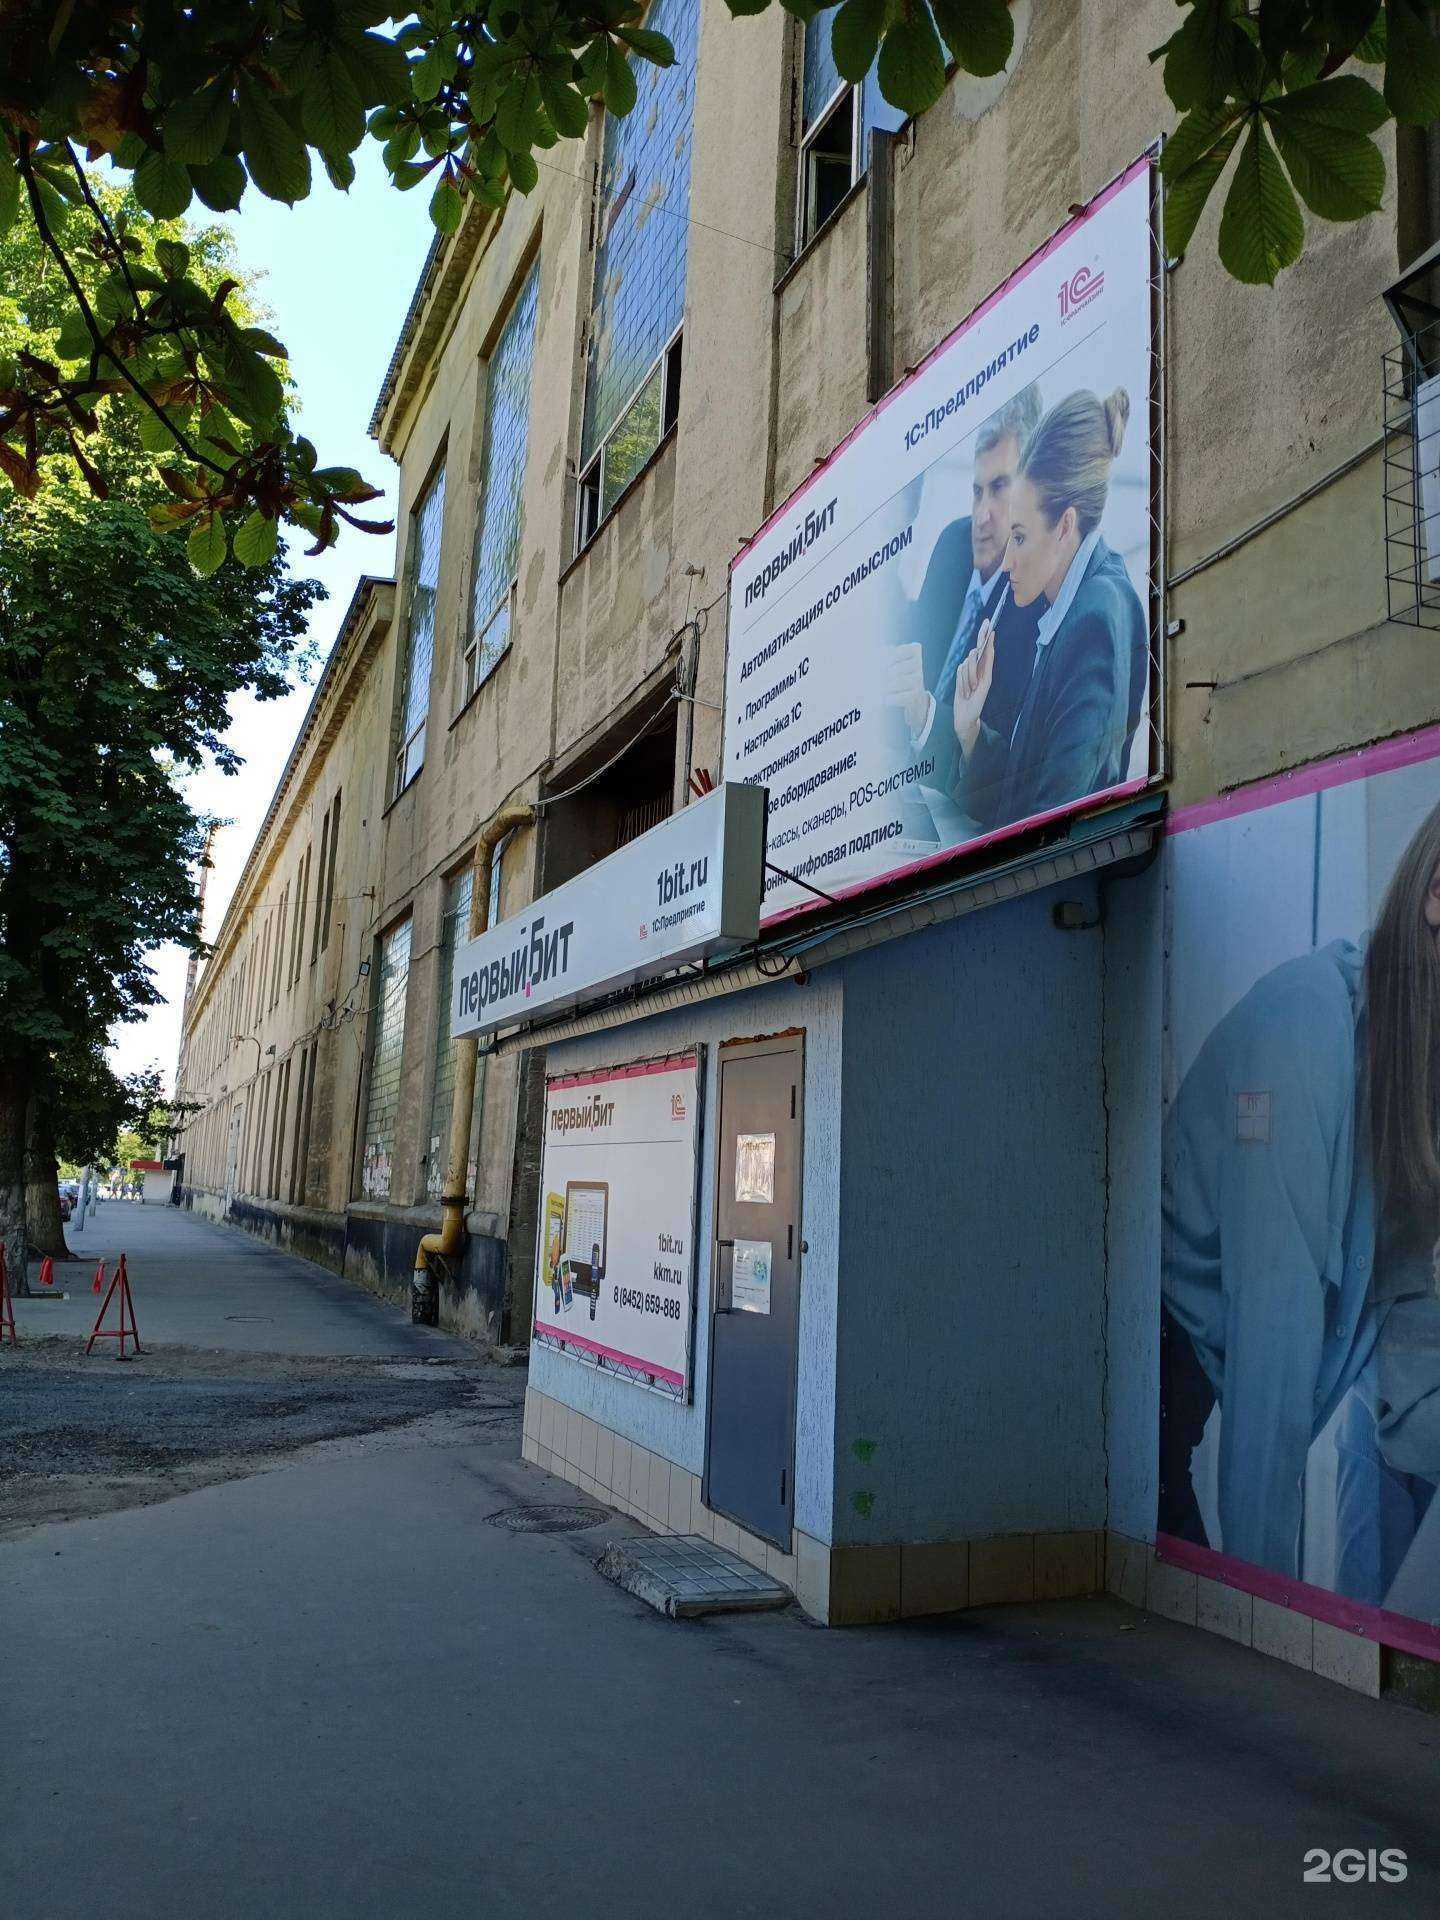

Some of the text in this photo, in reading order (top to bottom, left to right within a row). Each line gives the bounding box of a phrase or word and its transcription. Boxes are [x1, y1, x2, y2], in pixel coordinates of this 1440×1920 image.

[904, 322, 1041, 451] 1С:Предприятие
[740, 525, 913, 683] Автоматизация со смыслом
[745, 657, 809, 720] Программы 1С
[744, 701, 802, 757] Настройка 1С
[801, 707, 861, 755] отчетность
[780, 751, 857, 807] оборудование:
[802, 802, 848, 835] сканеры,
[849, 756, 935, 811] POS-системы
[848, 819, 903, 856] подпись
[657, 856, 708, 906] 1bit.ru
[658, 1233, 683, 1255] 1bit.ru
[653, 1261, 682, 1285] kkm.ru
[613, 1286, 680, 1320] 8 (8452) 659-888
